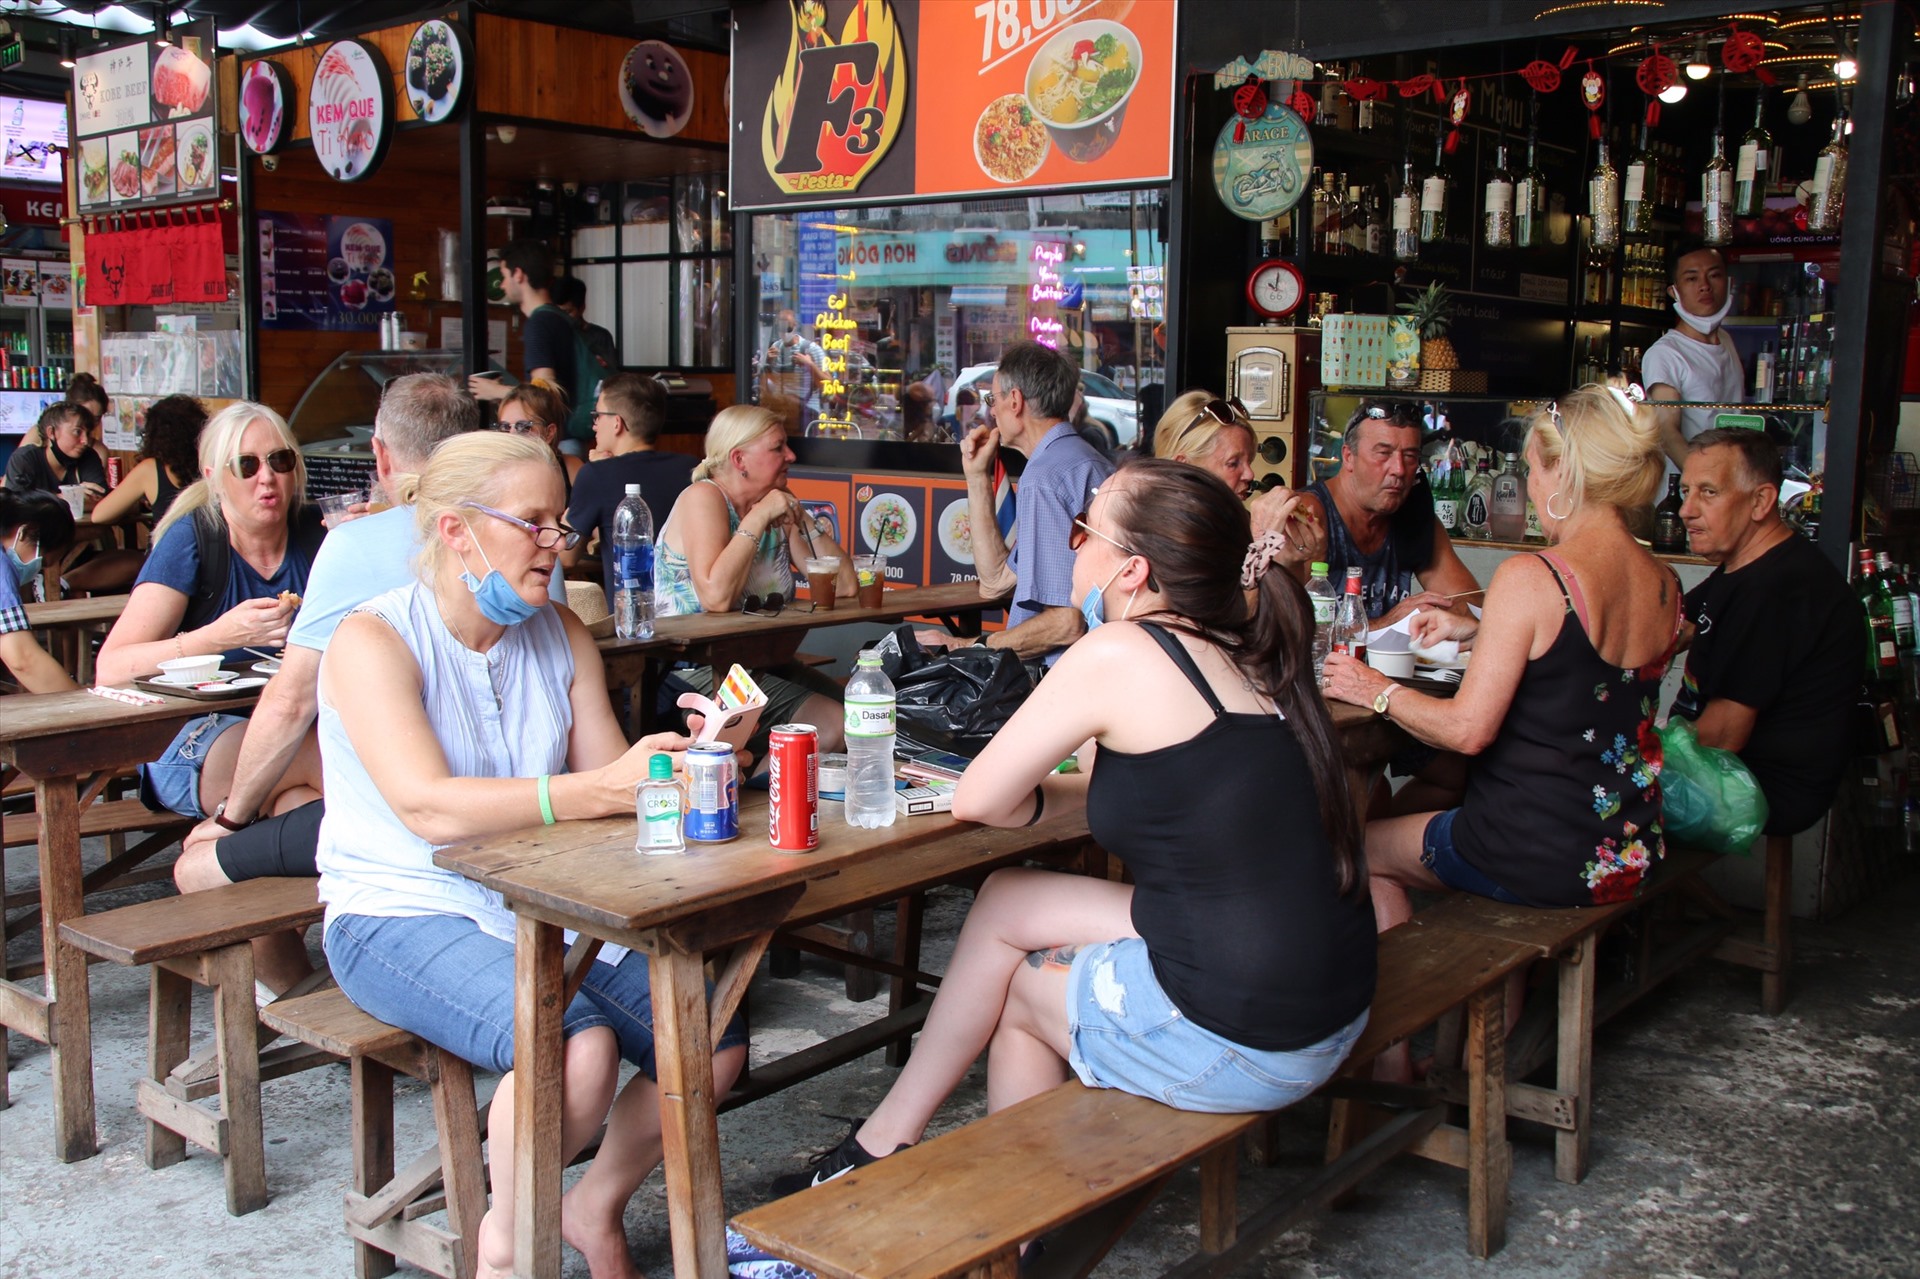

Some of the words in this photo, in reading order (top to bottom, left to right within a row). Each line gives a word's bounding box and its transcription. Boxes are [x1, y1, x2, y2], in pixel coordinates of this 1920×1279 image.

[100, 86, 122, 104] KOBE
[125, 80, 148, 98] BEEF
[316, 103, 344, 125] KEM
[349, 97, 375, 119] QUE
[317, 129, 332, 156] Ti
[1242, 126, 1291, 143] ARAGE
[1269, 292, 1283, 301] 66
[815, 311, 858, 330] Chicken
[1456, 303, 1472, 318] Our
[1473, 304, 1501, 321] Locals
[821, 333, 851, 354] Beef
[821, 354, 846, 373] Pork
[820, 379, 846, 396] Tofu
[862, 710, 891, 720] Dasan
[647, 799, 678, 809] CROSS
